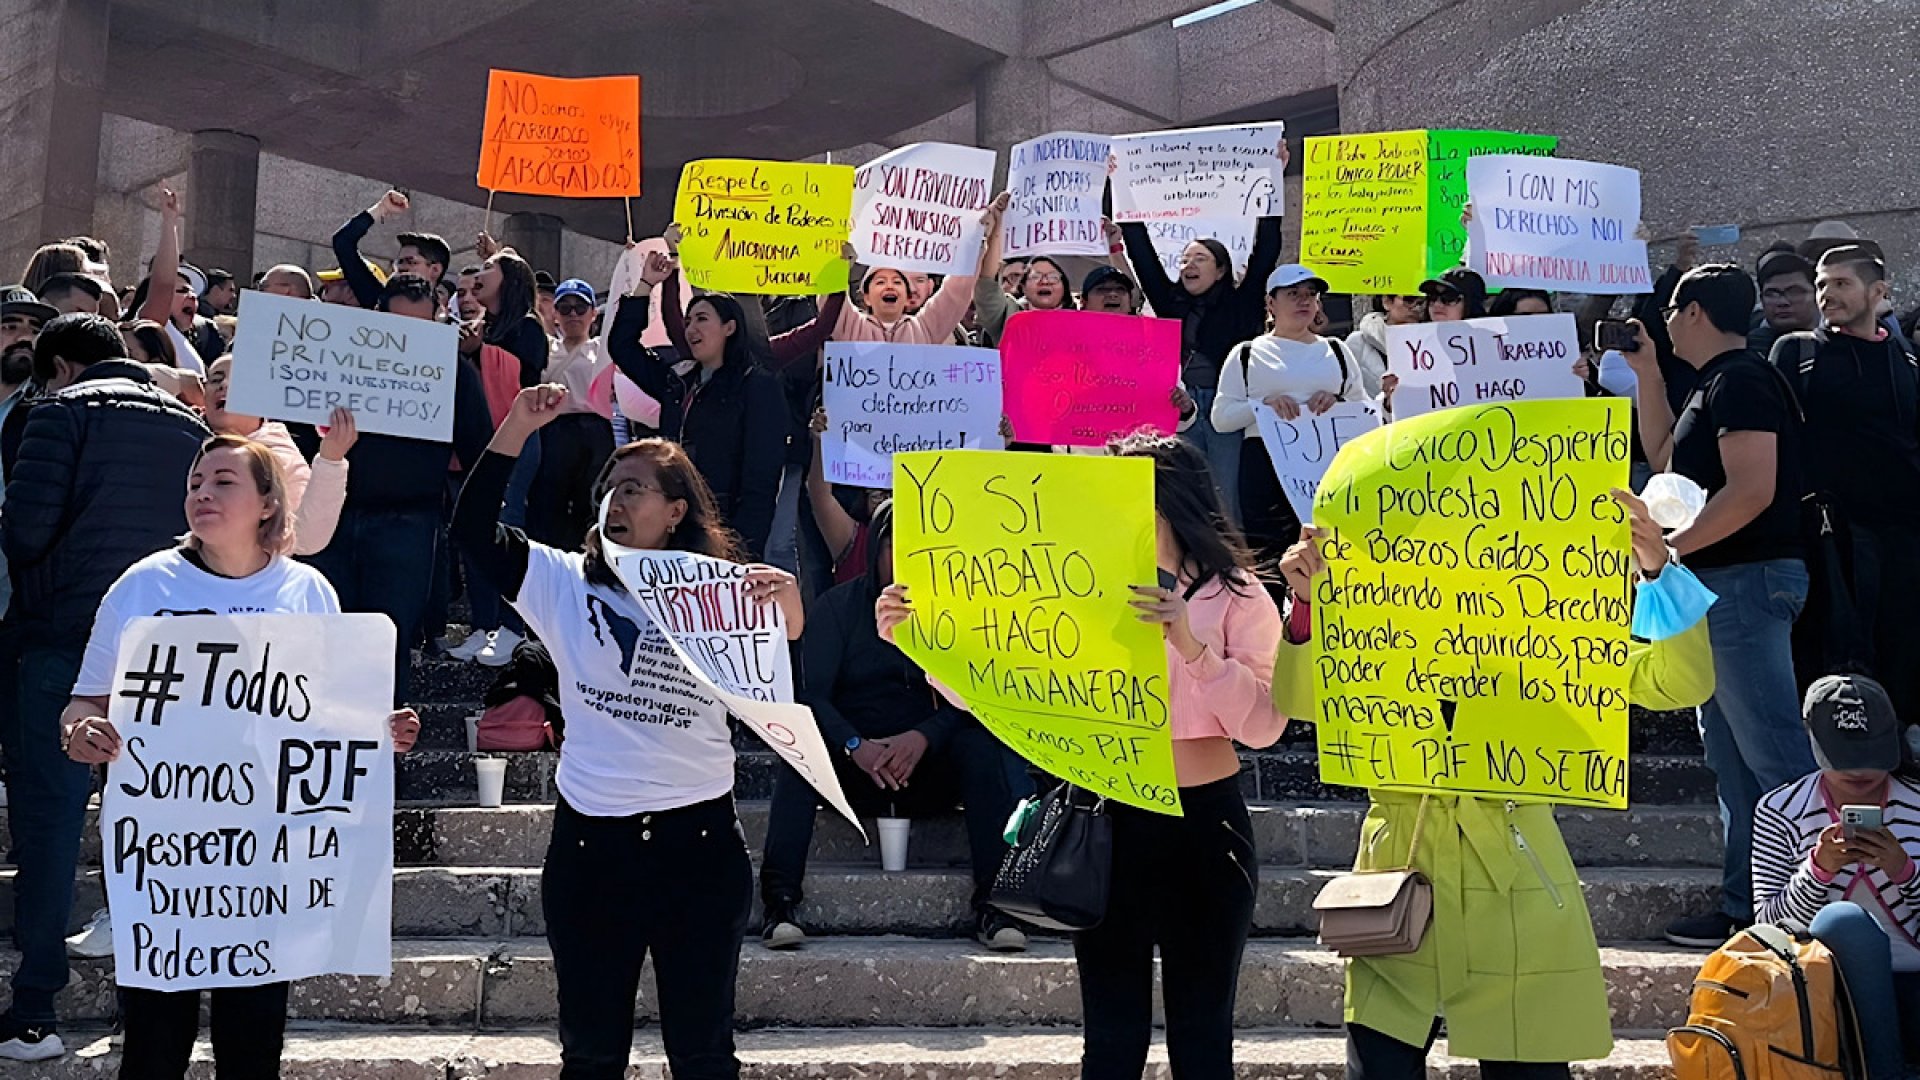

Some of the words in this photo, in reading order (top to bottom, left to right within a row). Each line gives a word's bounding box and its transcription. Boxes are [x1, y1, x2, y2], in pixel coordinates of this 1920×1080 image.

[502, 80, 539, 115] NO
[685, 163, 770, 197] Respeto
[804, 171, 820, 198] la
[876, 163, 910, 198] SON
[1024, 175, 1036, 198] DE
[1566, 178, 1600, 209] MIS
[764, 205, 781, 225] de
[872, 202, 903, 229] SON
[1495, 207, 1579, 236] DERECHOS
[1485, 251, 1592, 282] INDEPENDENCIA
[1599, 263, 1649, 285] JUDICIAL
[277, 312, 332, 342] NO
[350, 325, 407, 353] SON
[271, 340, 446, 381] PRIVILEGIOS
[1405, 339, 1435, 370] Yo
[1447, 335, 1477, 366] SI
[1493, 334, 1568, 362] TRABAJO
[340, 372, 431, 394] NUESTROS
[888, 354, 938, 392] toca
[941, 362, 998, 385] #PJF
[284, 385, 442, 424] DERECHOS!
[861, 391, 971, 416] defendernos
[1430, 381, 1460, 409] NO
[1475, 378, 1527, 401] HAGO
[840, 420, 873, 444] para
[1475, 406, 1628, 481] Despierta
[901, 456, 955, 535] Yo
[983, 473, 1043, 535] SÍ
[1377, 471, 1500, 526] protesta
[1521, 473, 1578, 522] NO
[1591, 490, 1626, 524] es
[1322, 526, 1352, 562] de
[1364, 528, 1459, 570] Brazos
[1465, 523, 1550, 572] Caídos
[1562, 535, 1629, 605] estoy
[1317, 567, 1443, 611] defendiendo
[1456, 582, 1505, 618] mis
[1506, 574, 1630, 628] Derechos
[909, 601, 956, 651] NO
[971, 605, 1081, 660] HAGO
[1319, 606, 1417, 651] laborales
[1434, 622, 1570, 670] adquiridos,
[1571, 636, 1628, 678] para
[967, 658, 1168, 729] MAÑANERAS
[1405, 657, 1504, 698] defender
[1519, 661, 1557, 704] los
[1562, 669, 1628, 722] tuyos
[1087, 731, 1152, 766] PJF
[119, 736, 255, 806] Somos
[276, 738, 379, 814] PJF
[1412, 738, 1471, 786] PJF
[1486, 740, 1527, 787] NO
[1535, 746, 1576, 793] SE
[1578, 749, 1626, 798] TOCA
[1126, 772, 1177, 807] toca
[271, 824, 289, 863] A
[308, 825, 339, 860] LA
[147, 879, 288, 919] DIVISION
[306, 878, 335, 909] DE
[132, 923, 277, 981] Poderes.
